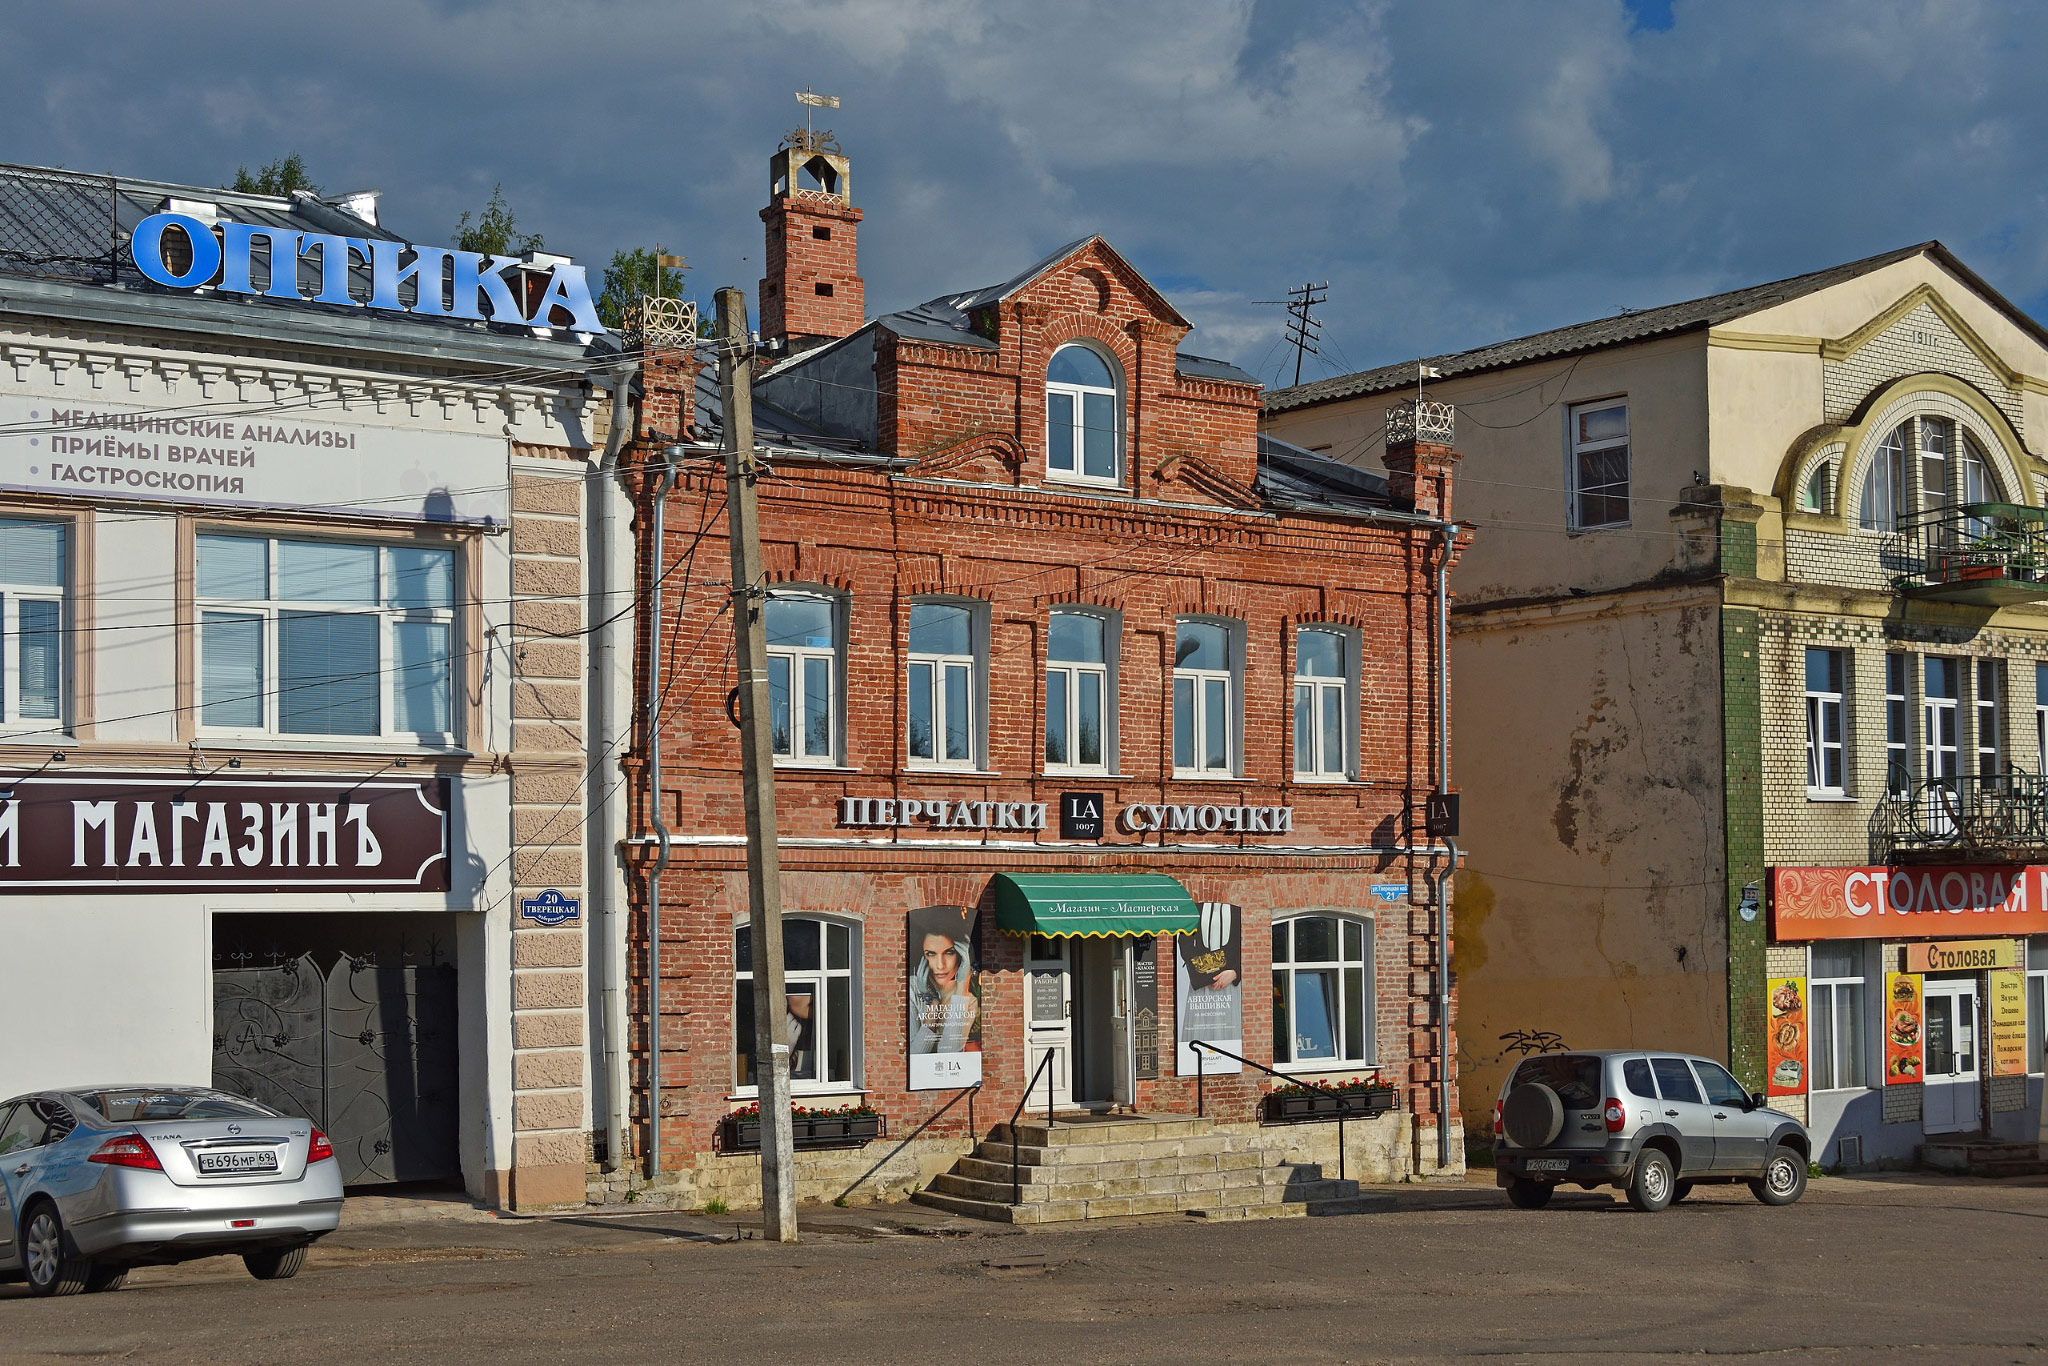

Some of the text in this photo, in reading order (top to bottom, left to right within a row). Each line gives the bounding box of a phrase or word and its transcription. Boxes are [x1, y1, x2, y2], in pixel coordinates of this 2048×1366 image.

[131, 213, 606, 334] ОПТИКА
[51, 407, 355, 449] МЕДИЦИНСКИЕ АНАЛИЗЫ
[51, 435, 255, 468] ПРИЁМЫ ВРАЧЕЙ
[51, 463, 244, 494] ГАСТРОСКОПИЯ
[842, 796, 1049, 830] ПЕРЧАТКИ
[1071, 798, 1100, 819] LA
[1430, 801, 1450, 819] LA
[1123, 803, 1295, 833] СУМОЧКИ
[70, 800, 383, 867] МАГАЗИНЪ
[1075, 823, 1095, 834] 1007
[545, 894, 558, 904] 20
[1386, 892, 1395, 900] 21
[1844, 871, 2027, 916] СТОЛОВАЯ
[525, 905, 576, 914] ТВЕРЕЦКАЯ
[1049, 902, 1100, 913] Магазин
[1110, 902, 1179, 915] Мастерская
[1928, 944, 1996, 969] Столовая
[2000, 982, 2018, 991] Быстро
[1188, 994, 1232, 1003] АВТОРСКАЯ
[1190, 1002, 1231, 1010] ВЫШИВКА
[917, 1011, 976, 1020] АКСЕССУАРОВ
[926, 1003, 966, 1013] МАГАЗИН
[948, 1062, 961, 1070] LA
